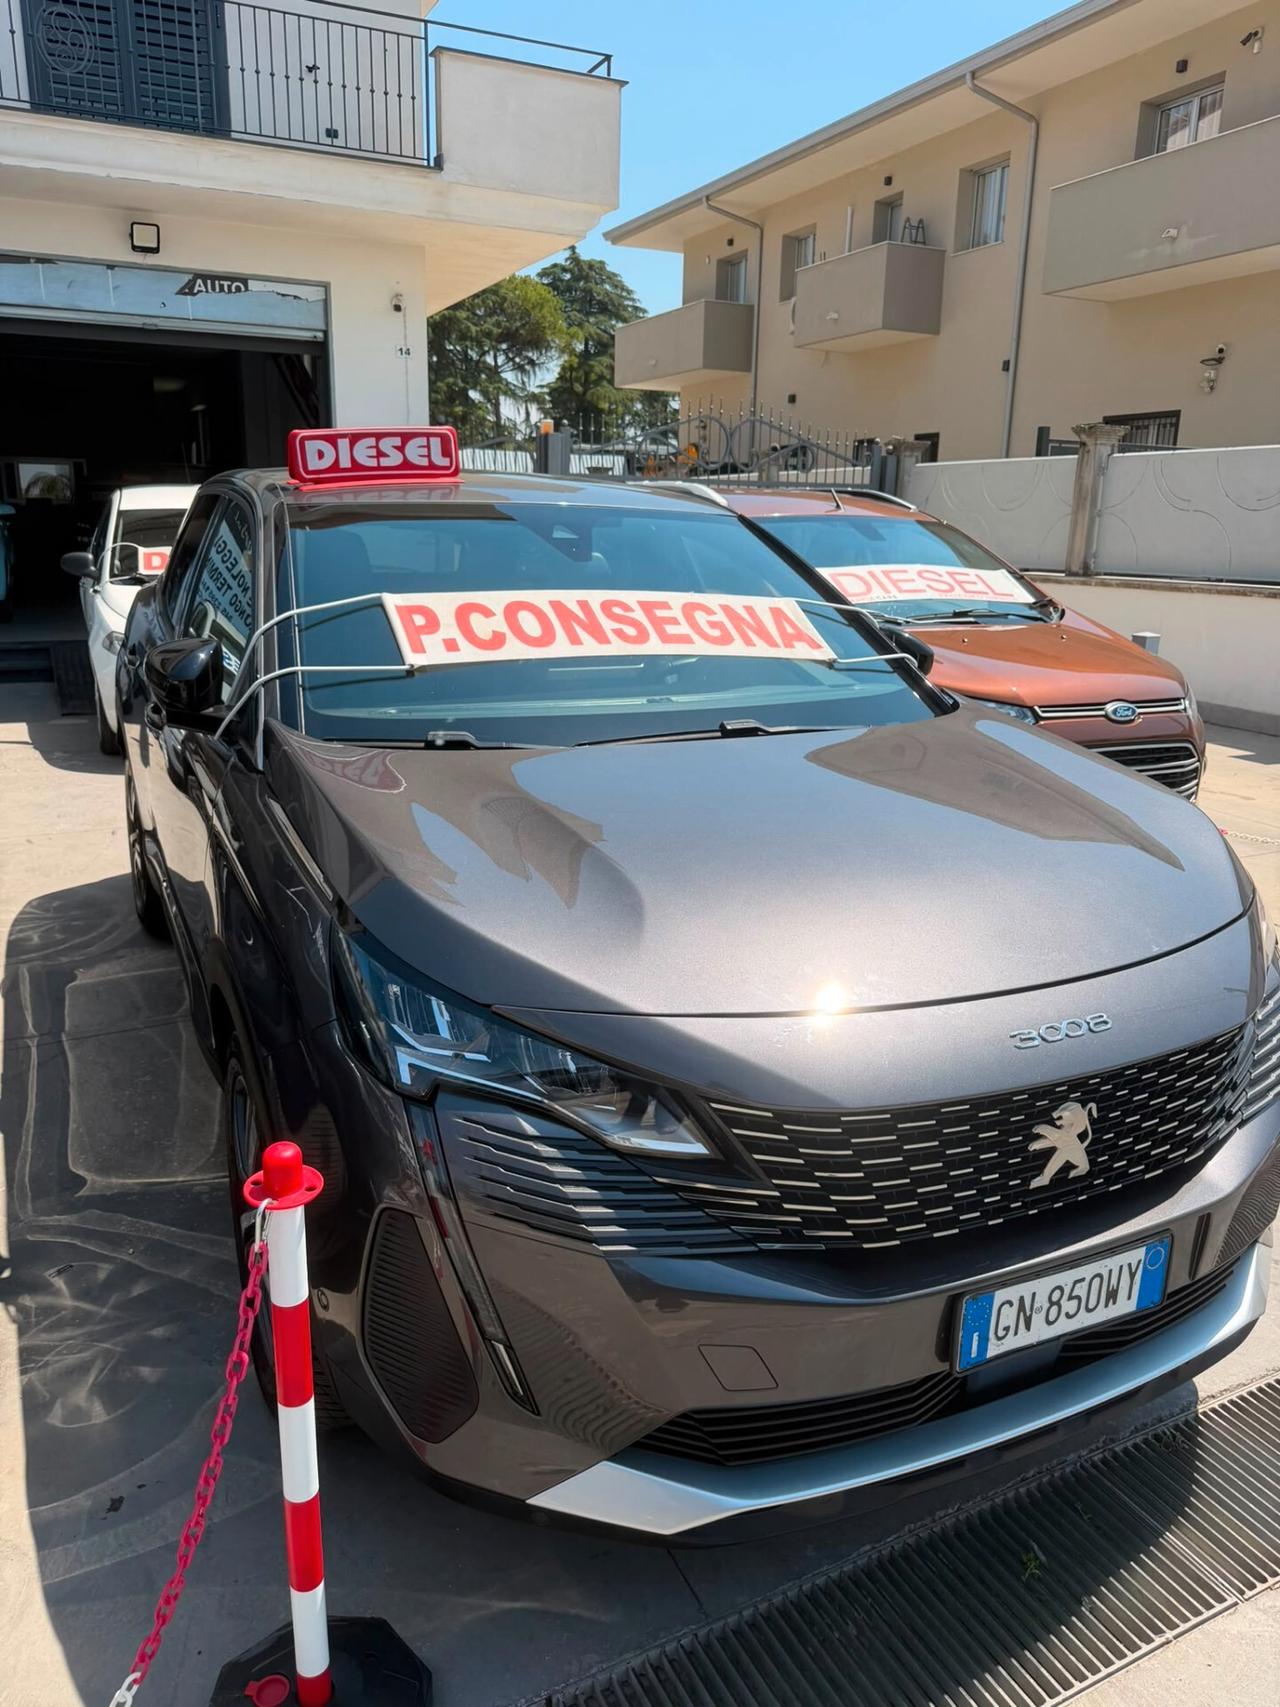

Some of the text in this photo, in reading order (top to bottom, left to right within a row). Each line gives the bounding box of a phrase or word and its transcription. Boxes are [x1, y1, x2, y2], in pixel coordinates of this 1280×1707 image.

[194, 279, 245, 293] AUTO
[304, 437, 450, 470] DIESEL
[828, 569, 1015, 599] DIESEL
[394, 600, 824, 653] P.CONSEGNA
[1009, 1013, 1112, 1049] 3008
[993, 1259, 1142, 1342] GN 850WY
